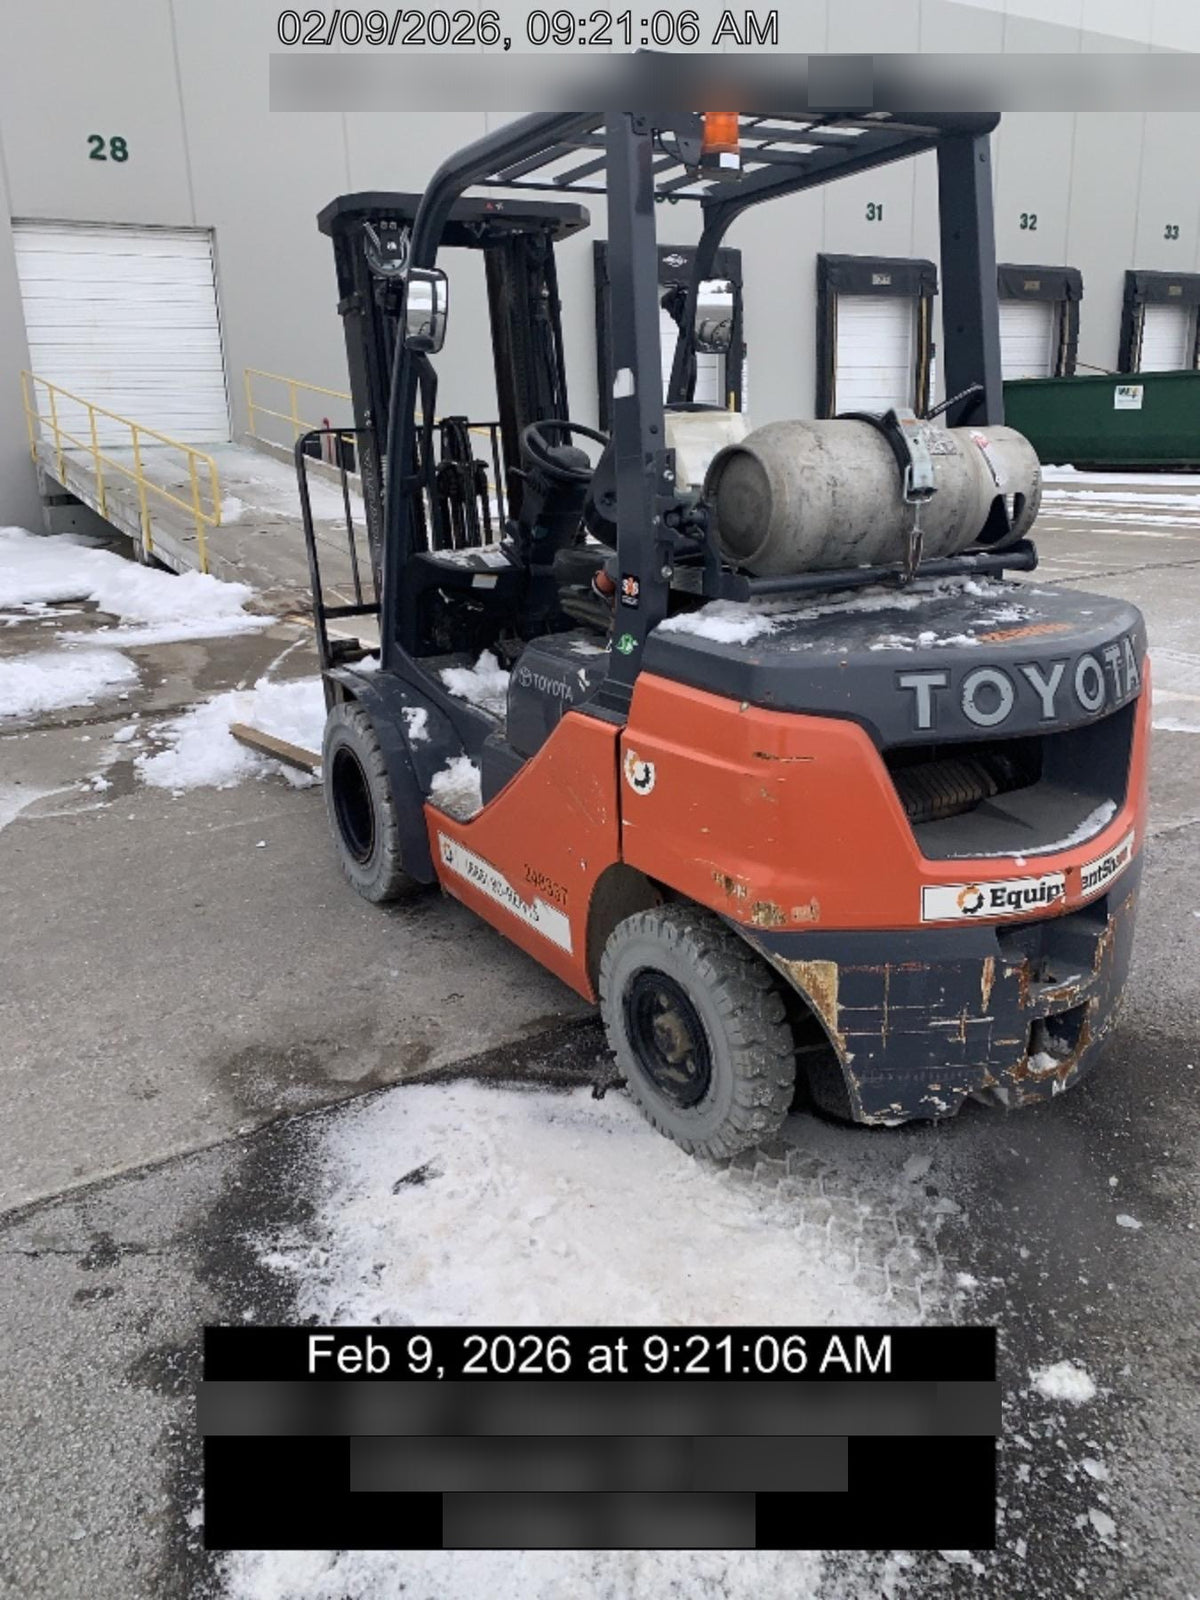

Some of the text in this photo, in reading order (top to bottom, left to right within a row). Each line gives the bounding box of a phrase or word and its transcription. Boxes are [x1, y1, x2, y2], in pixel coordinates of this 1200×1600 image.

[88, 135, 128, 162] 28
[866, 203, 882, 221] 31
[1020, 213, 1037, 230] 32
[1164, 225, 1179, 240] 33
[533, 673, 573, 702] TOYOTA
[900, 634, 1139, 727] TOYOTA
